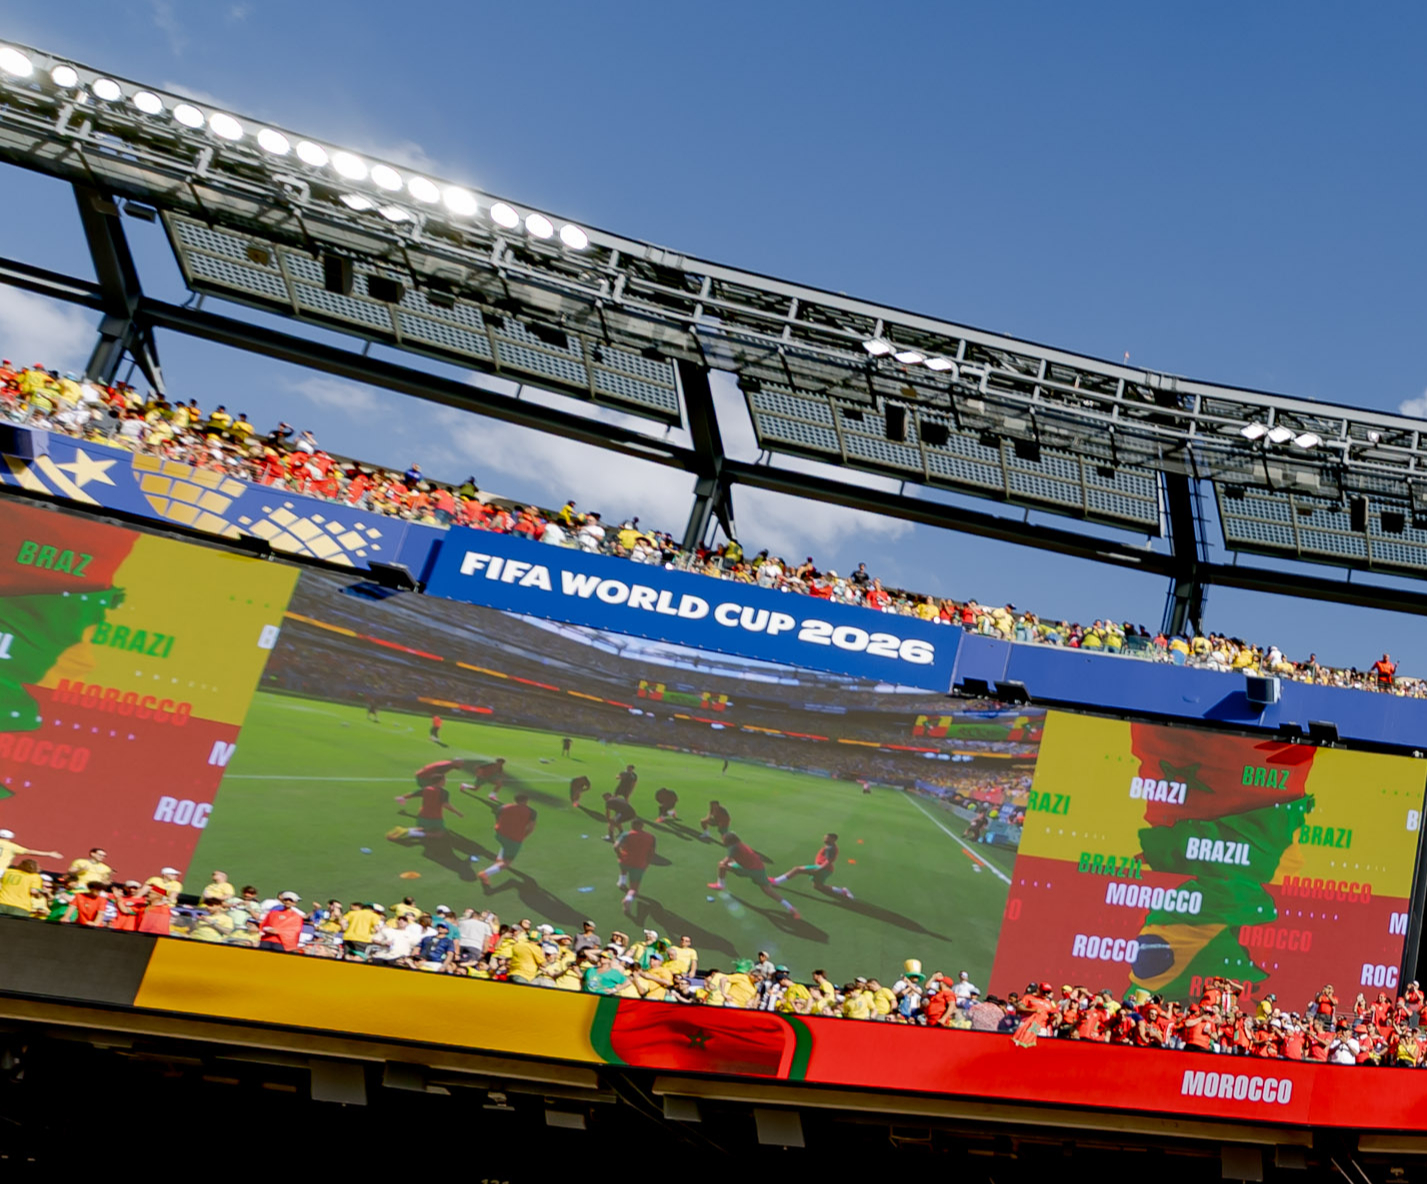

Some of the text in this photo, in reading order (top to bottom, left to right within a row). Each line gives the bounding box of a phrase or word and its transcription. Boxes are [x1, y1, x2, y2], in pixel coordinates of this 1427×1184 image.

[16, 540, 93, 577] BRAZ
[460, 550, 935, 665] FIFA WORLD CUP 2026
[91, 621, 175, 658] BRAZI
[52, 678, 192, 727] MOROCCO
[1129, 776, 1187, 805] BRAZI
[1241, 765, 1290, 790] BRAZ
[1185, 837, 1250, 866] BRAZIL
[1299, 824, 1353, 849] BRAZI
[1078, 852, 1143, 880] BRAZIL
[1105, 882, 1203, 915] MOROCCO
[1281, 875, 1372, 904] MOROCCO
[1072, 934, 1139, 964] ROCCO
[1181, 1069, 1293, 1105] MOROCCO
